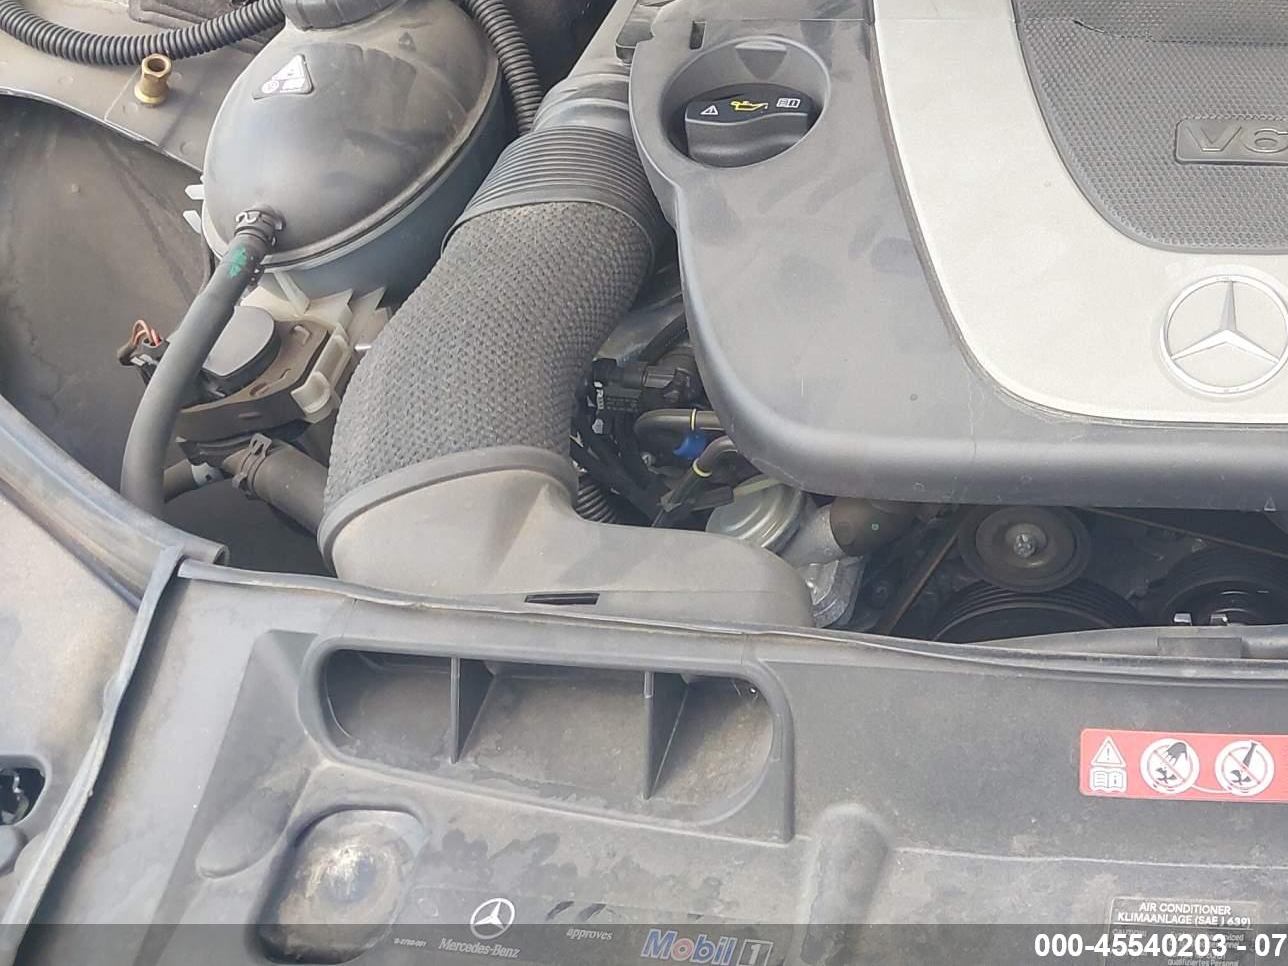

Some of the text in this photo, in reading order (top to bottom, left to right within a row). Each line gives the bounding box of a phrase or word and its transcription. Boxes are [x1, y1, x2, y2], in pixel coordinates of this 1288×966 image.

[1139, 902, 1232, 916] AIR CONDITIONER
[1117, 912, 1193, 925] KLIMAANLAGE
[1194, 915, 1218, 927] (SAE
[1227, 918, 1251, 930] 639)
[566, 928, 614, 941] approves
[438, 937, 520, 959] Mercedes-Benz
[640, 929, 738, 966] Mobil
